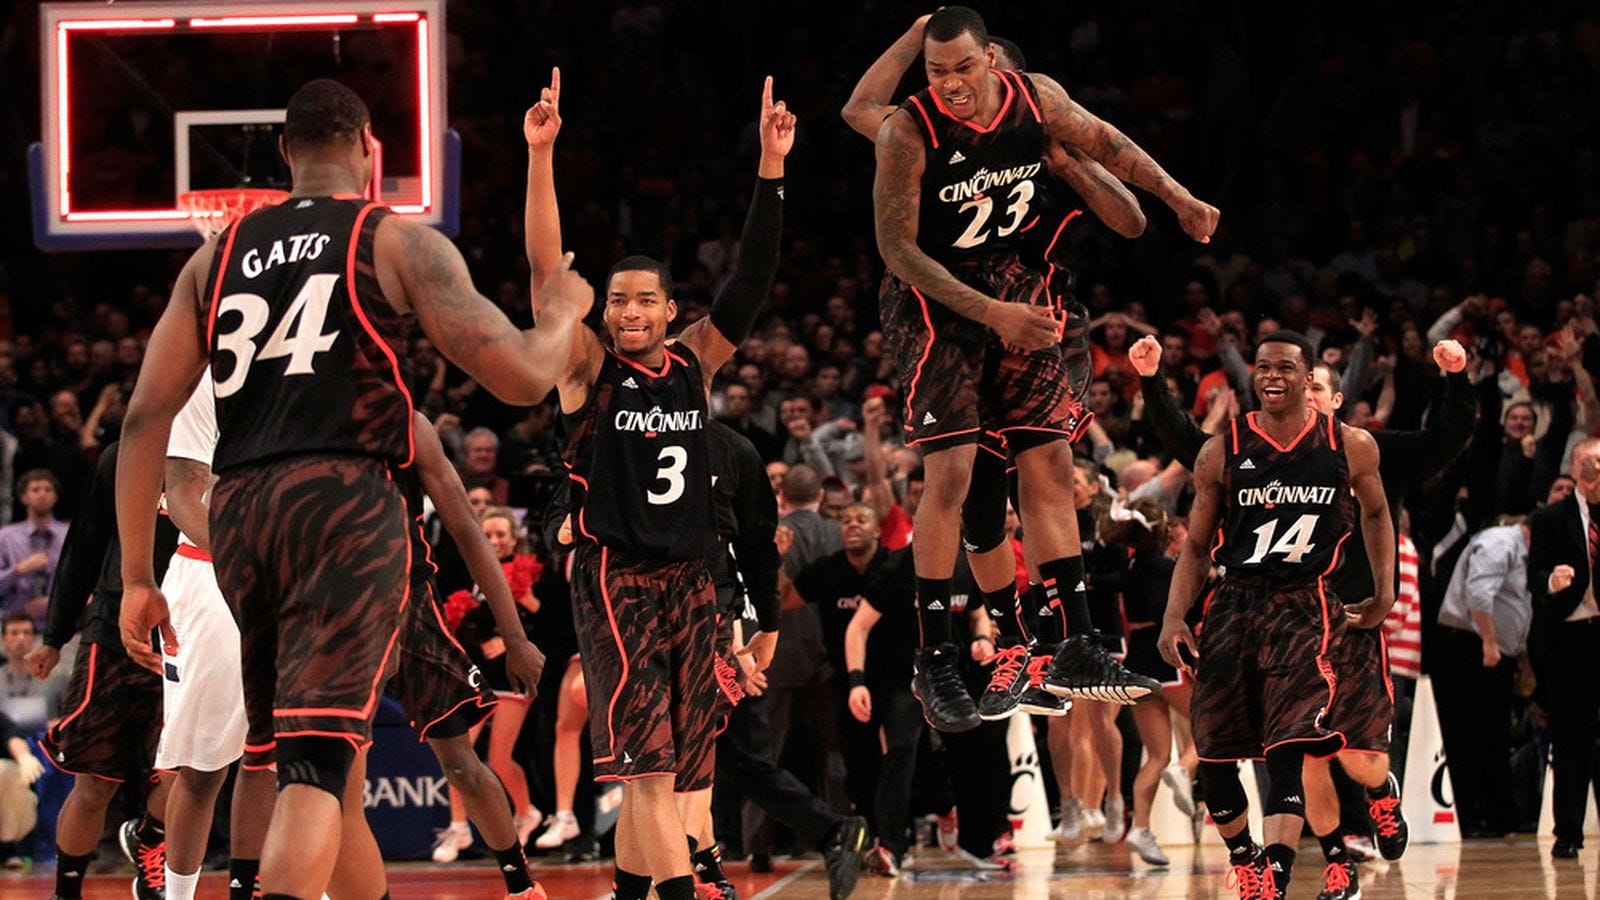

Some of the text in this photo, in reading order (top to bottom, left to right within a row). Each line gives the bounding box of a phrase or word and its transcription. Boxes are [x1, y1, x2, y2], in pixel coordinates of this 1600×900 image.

[939, 162, 1041, 203] CINCINNATI
[951, 179, 1035, 249] 23
[214, 273, 341, 399] 34
[647, 445, 688, 505] 3
[1238, 484, 1336, 507] CINCINNATI
[1242, 514, 1320, 565] 14
[363, 776, 450, 808] BANK
